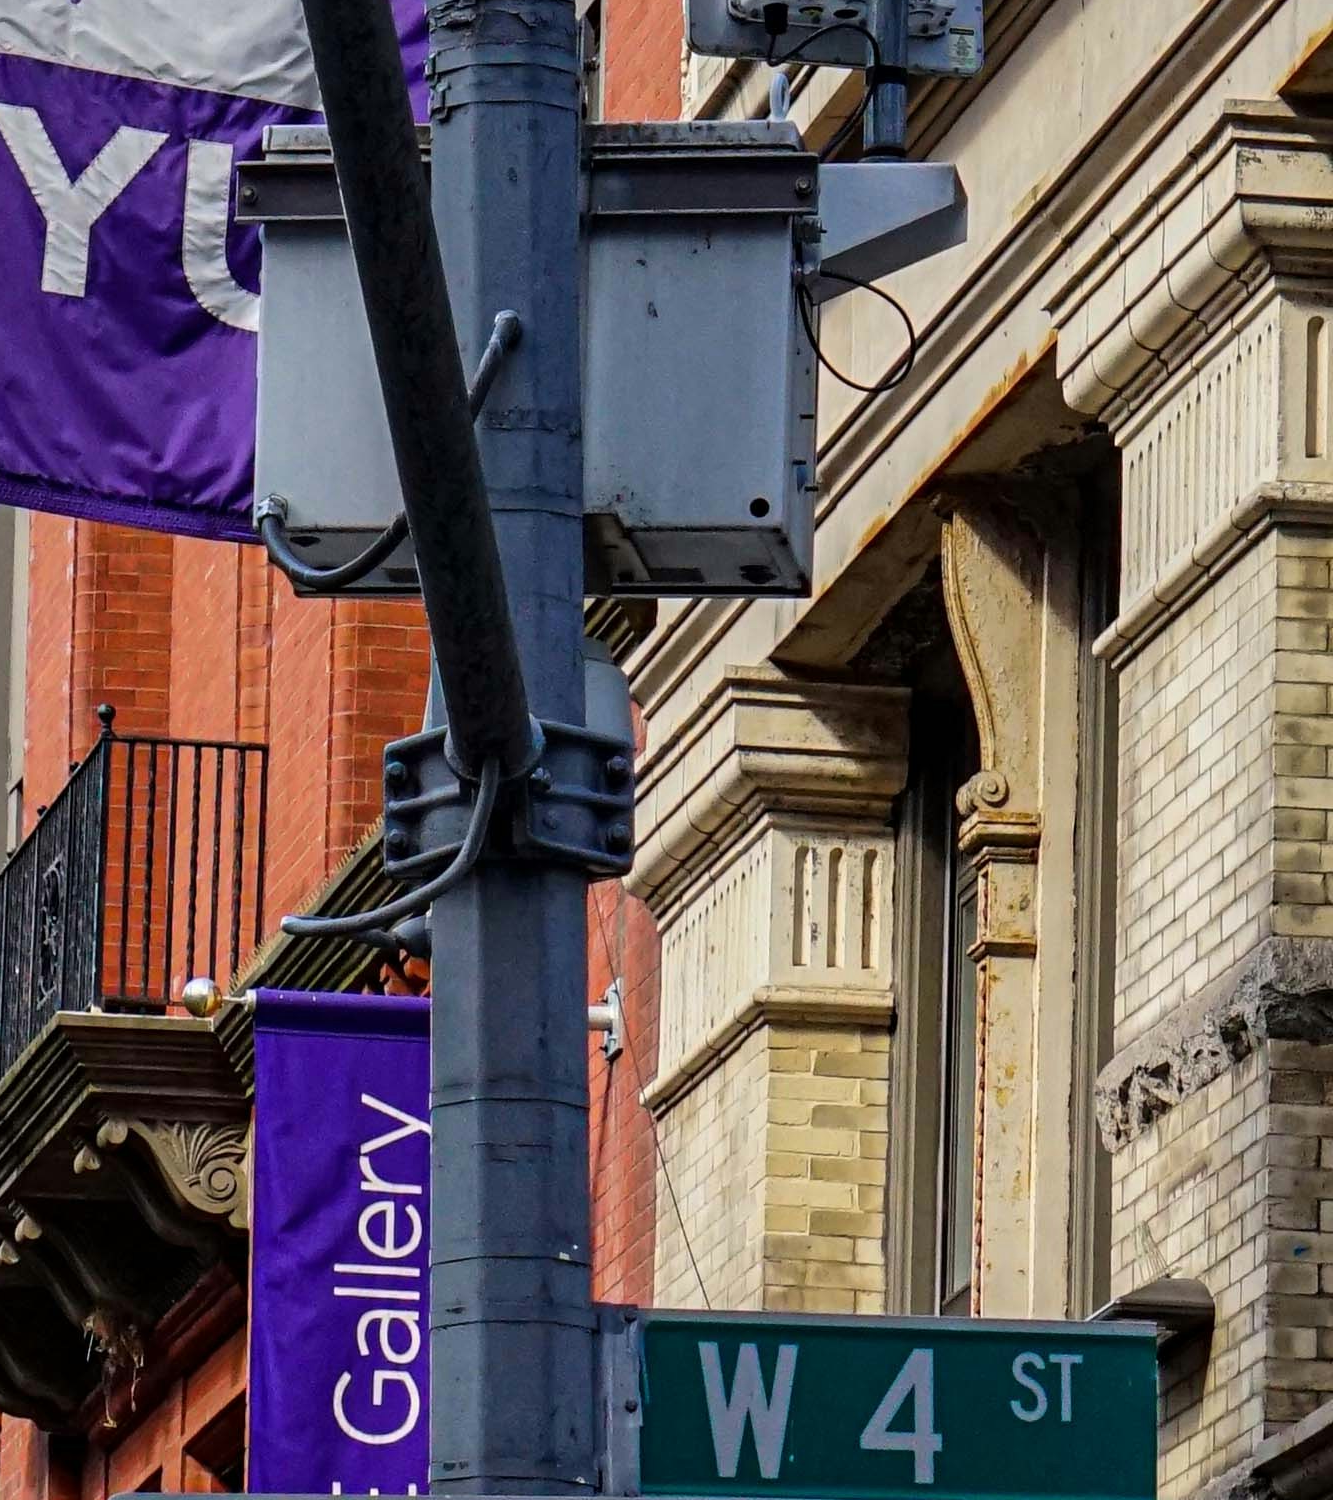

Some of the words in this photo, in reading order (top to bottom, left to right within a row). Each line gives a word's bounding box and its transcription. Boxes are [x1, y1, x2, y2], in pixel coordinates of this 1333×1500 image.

[333, 1093, 431, 1445] Gallery
[698, 1341, 799, 1480] W
[859, 1348, 943, 1485] 4
[1010, 1350, 1084, 1423] ST
